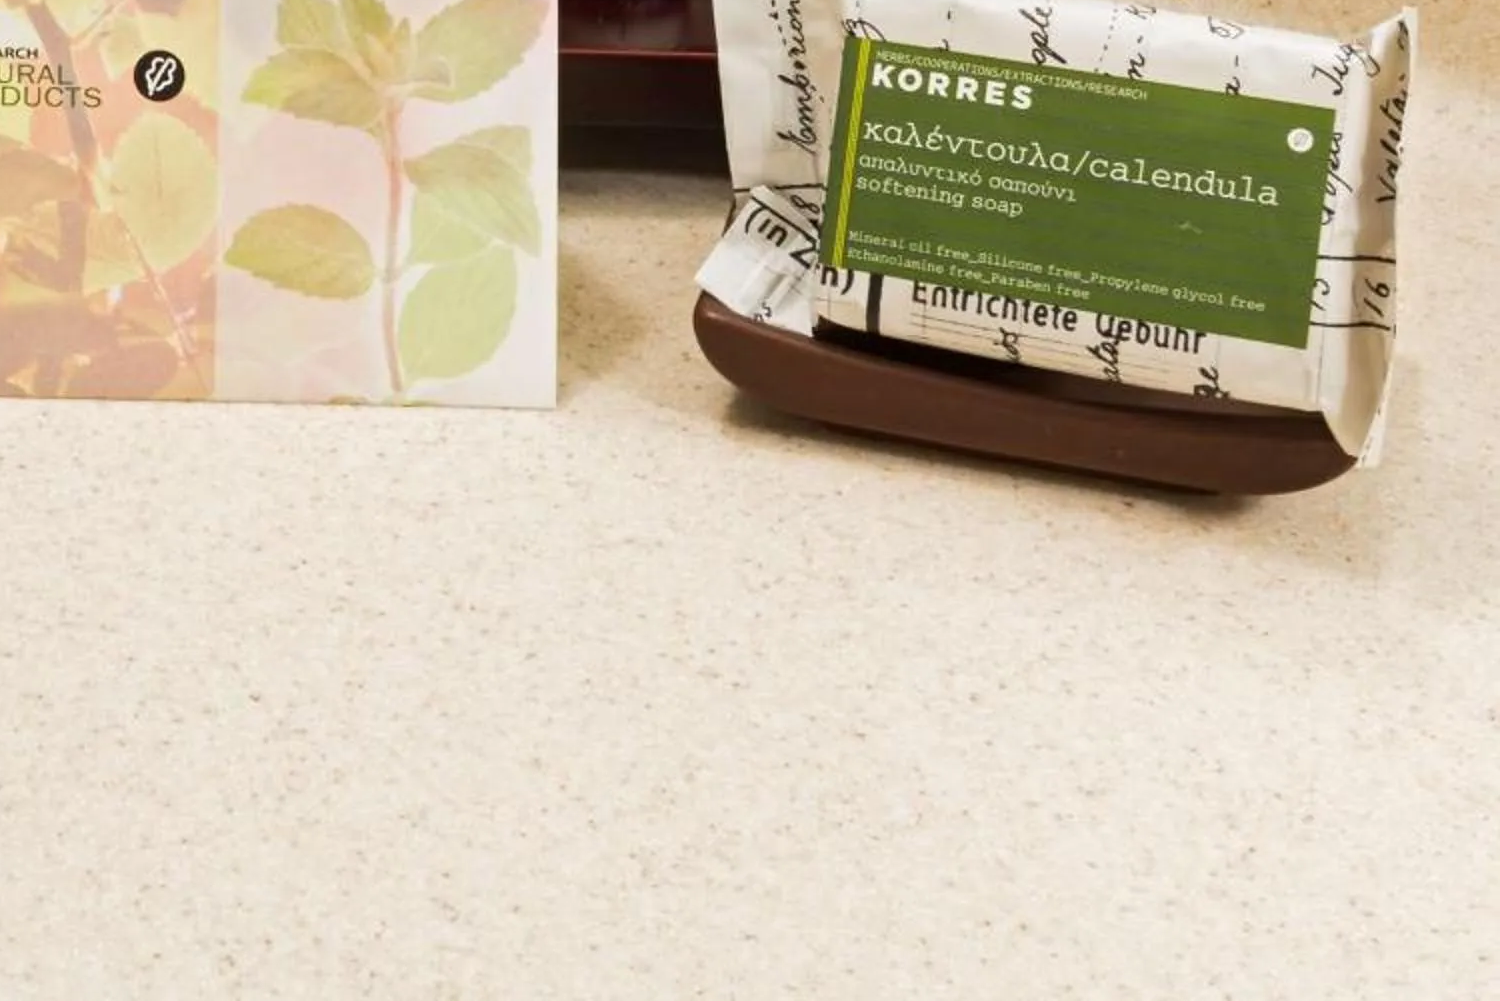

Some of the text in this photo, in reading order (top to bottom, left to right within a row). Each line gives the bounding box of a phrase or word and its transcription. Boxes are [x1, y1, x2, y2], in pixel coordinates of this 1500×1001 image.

[871, 63, 1033, 110] KORRES
[876, 50, 1148, 101] HERBS/COOPERATIONS/EXTRACTIONS/RESEARCH
[859, 153, 1077, 203] απαλυντικό σαπούνι
[863, 121, 1279, 206] καλέντουλα/calendula
[855, 175, 1023, 218] softening soap
[847, 247, 944, 275] Ethanolamine
[1055, 283, 1090, 300] free
[848, 230, 903, 249] Mineral
[908, 242, 932, 255] oil
[1171, 286, 1225, 307] glycol
[1229, 295, 1266, 312] free
